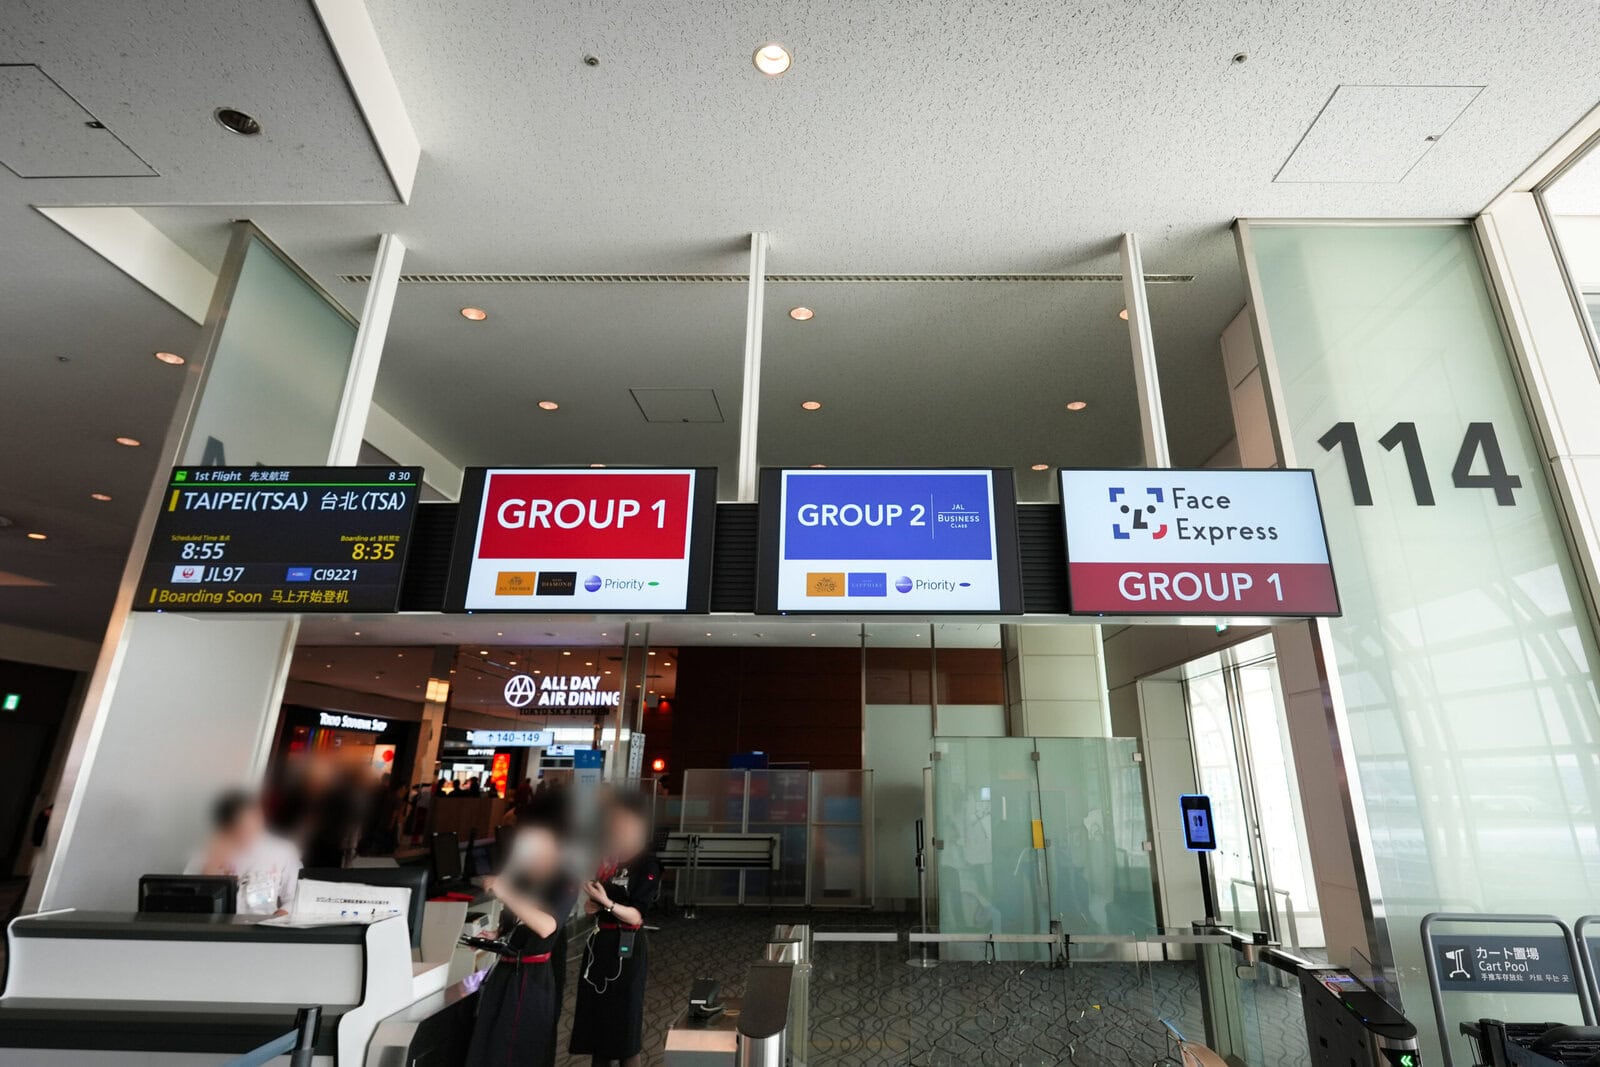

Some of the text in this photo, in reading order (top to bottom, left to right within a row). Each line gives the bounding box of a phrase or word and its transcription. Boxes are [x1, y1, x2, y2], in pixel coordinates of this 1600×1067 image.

[1317, 421, 1523, 506] 114
[194, 471, 242, 482] 1st Flight
[184, 491, 309, 512] TAIPEI(TSA)
[1172, 487, 1231, 510] Face
[497, 498, 666, 530] GROUP 1
[798, 503, 926, 527] GROUP 2
[951, 503, 965, 511] JAL
[1176, 517, 1279, 546] Express
[181, 542, 226, 560] 8:55
[351, 543, 396, 560] 8:35
[204, 566, 245, 582] JL97
[313, 568, 358, 581] CI9221
[604, 578, 645, 592] Priority
[915, 579, 956, 593] Priority
[1118, 571, 1283, 602] GROUP 1
[158, 588, 262, 604] Boarding Soon
[270, 589, 349, 604] 马上开始登机
[540, 676, 601, 691] ALL DAY
[538, 691, 567, 707] AIR
[1476, 946, 1540, 961] カート置場
[1478, 961, 1529, 972] Cart Pool
